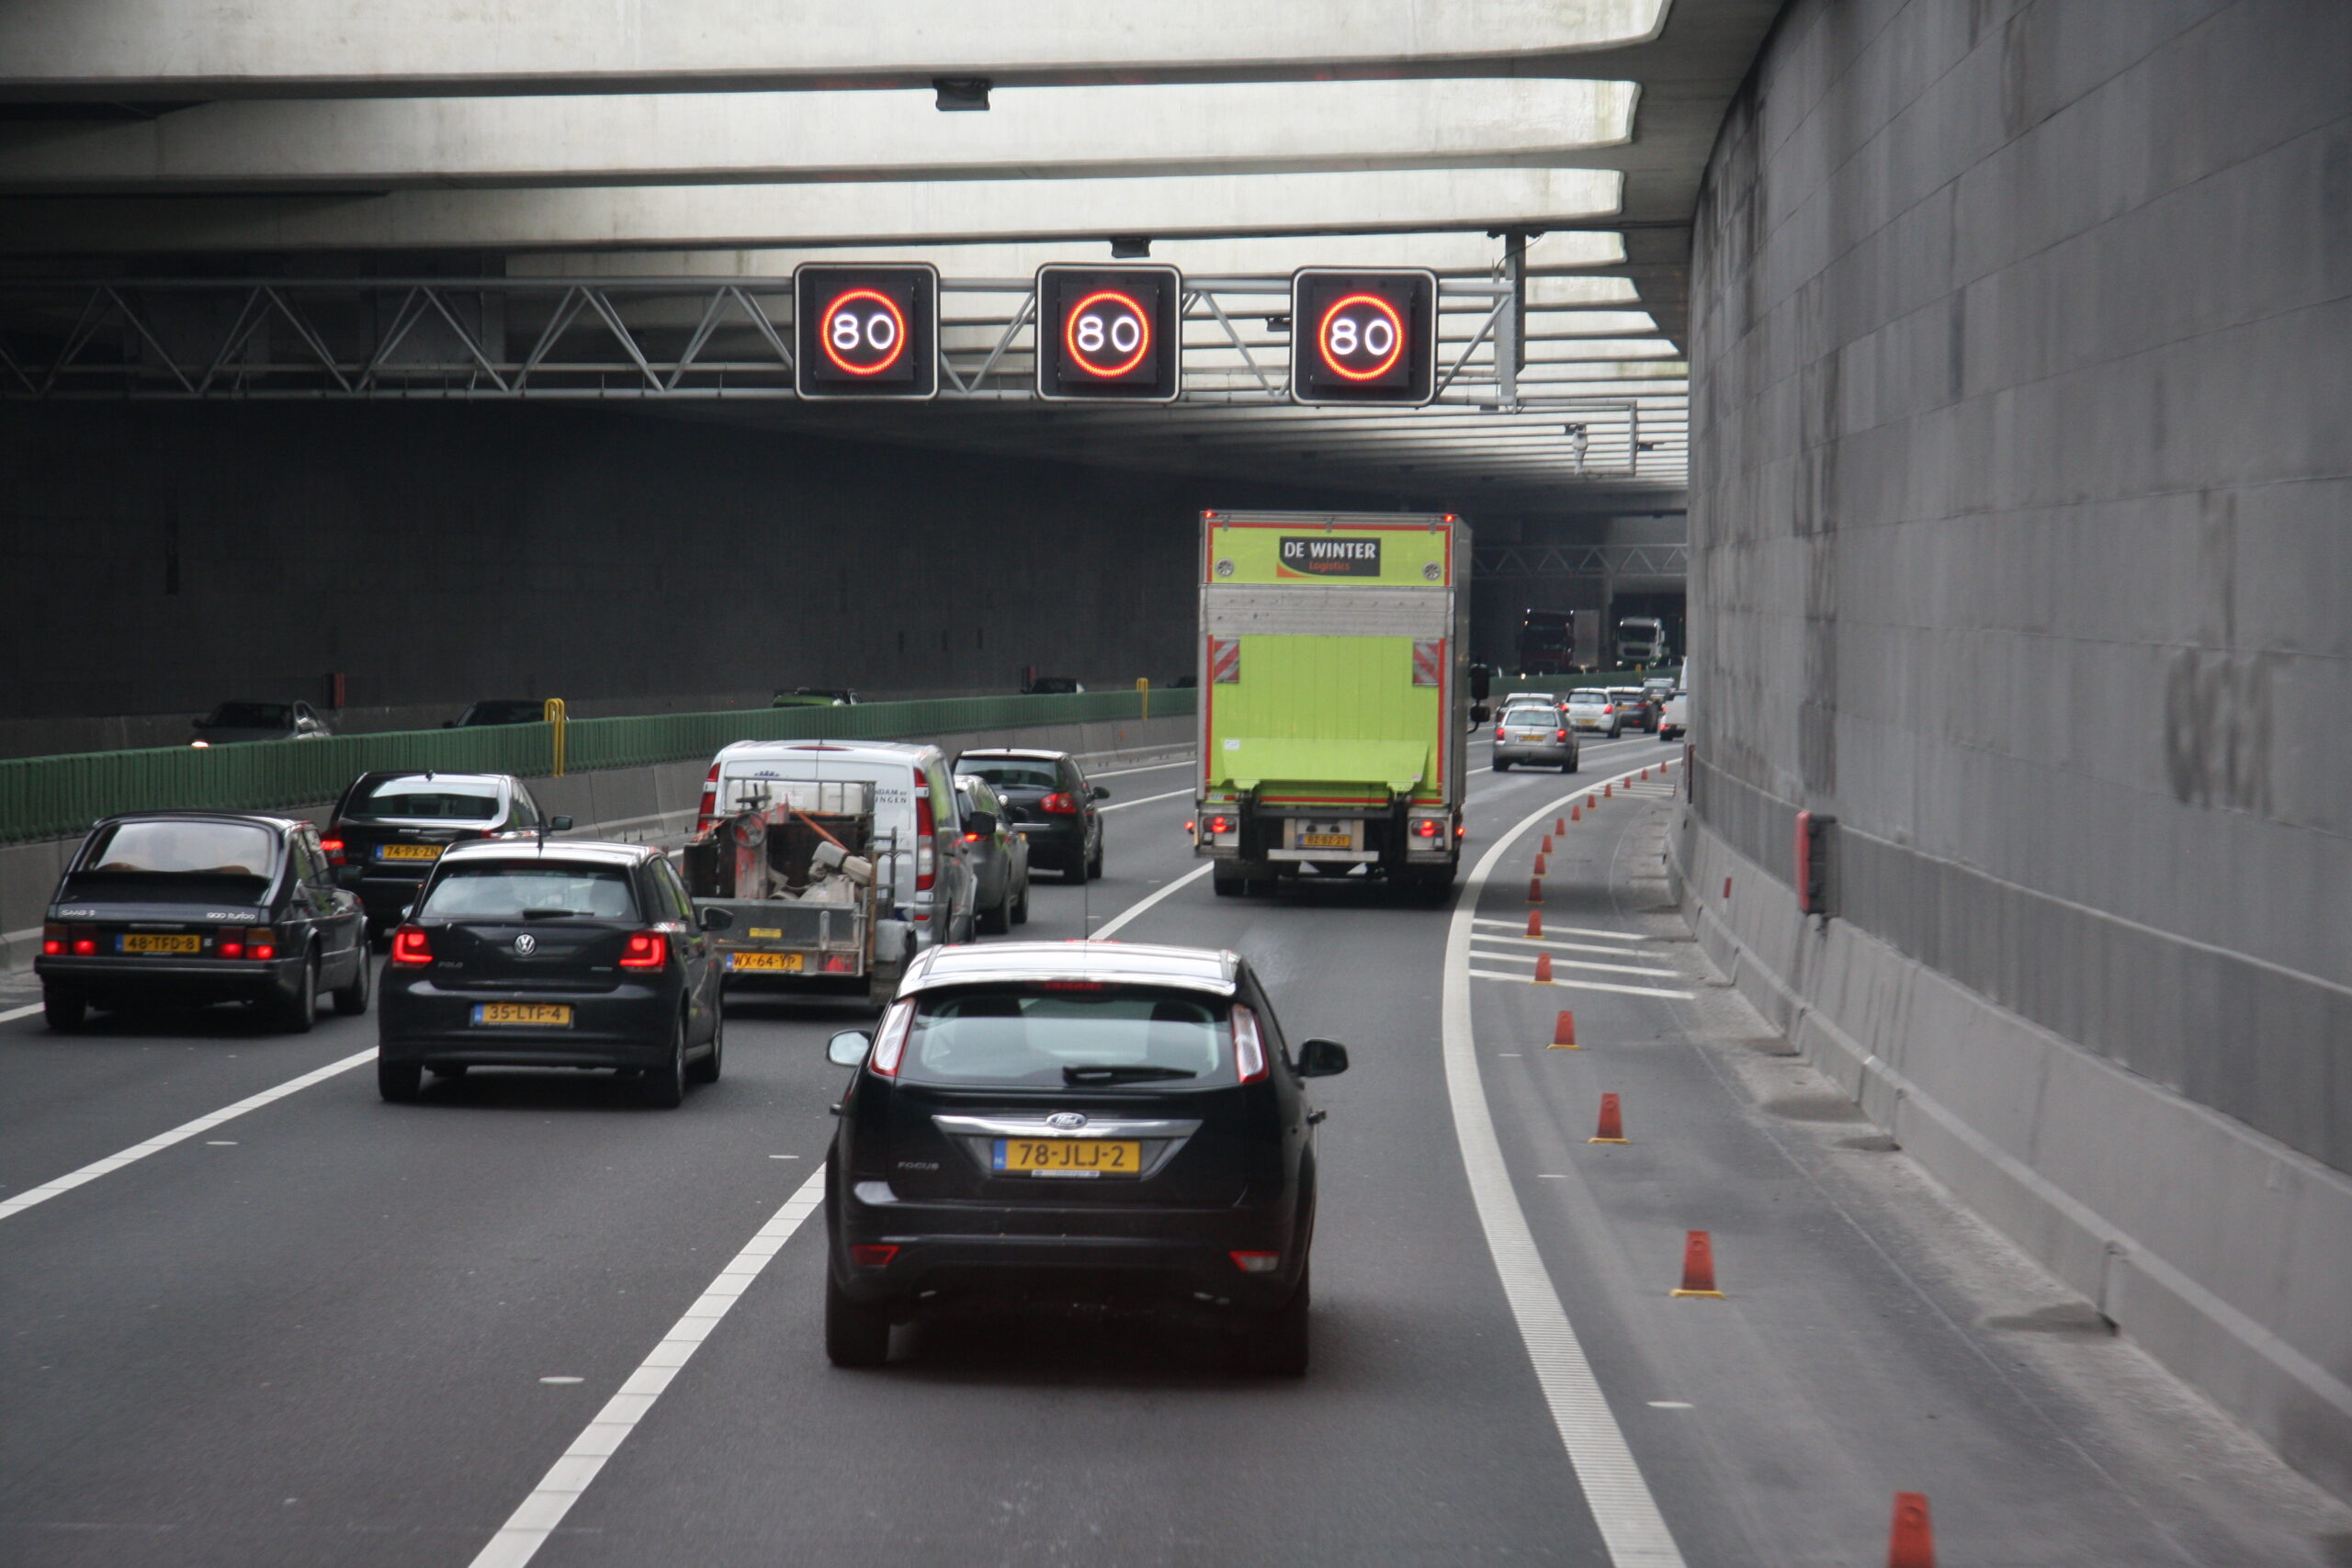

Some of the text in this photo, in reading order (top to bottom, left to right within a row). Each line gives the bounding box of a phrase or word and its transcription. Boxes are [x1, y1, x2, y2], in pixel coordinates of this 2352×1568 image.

[833, 314, 895, 350] 80
[1078, 316, 1139, 353] 80
[1330, 319, 1393, 355] 80
[1284, 542, 1376, 558] DE WINTER
[1309, 561, 1351, 572] Logistics
[388, 845, 439, 856] 74-PX-ZN
[229, 910, 256, 920] turbo
[128, 936, 196, 950] 48-TFD-8
[489, 1005, 562, 1021] 35-LTF-4
[1019, 1143, 1125, 1168] 78-JLJ-2
